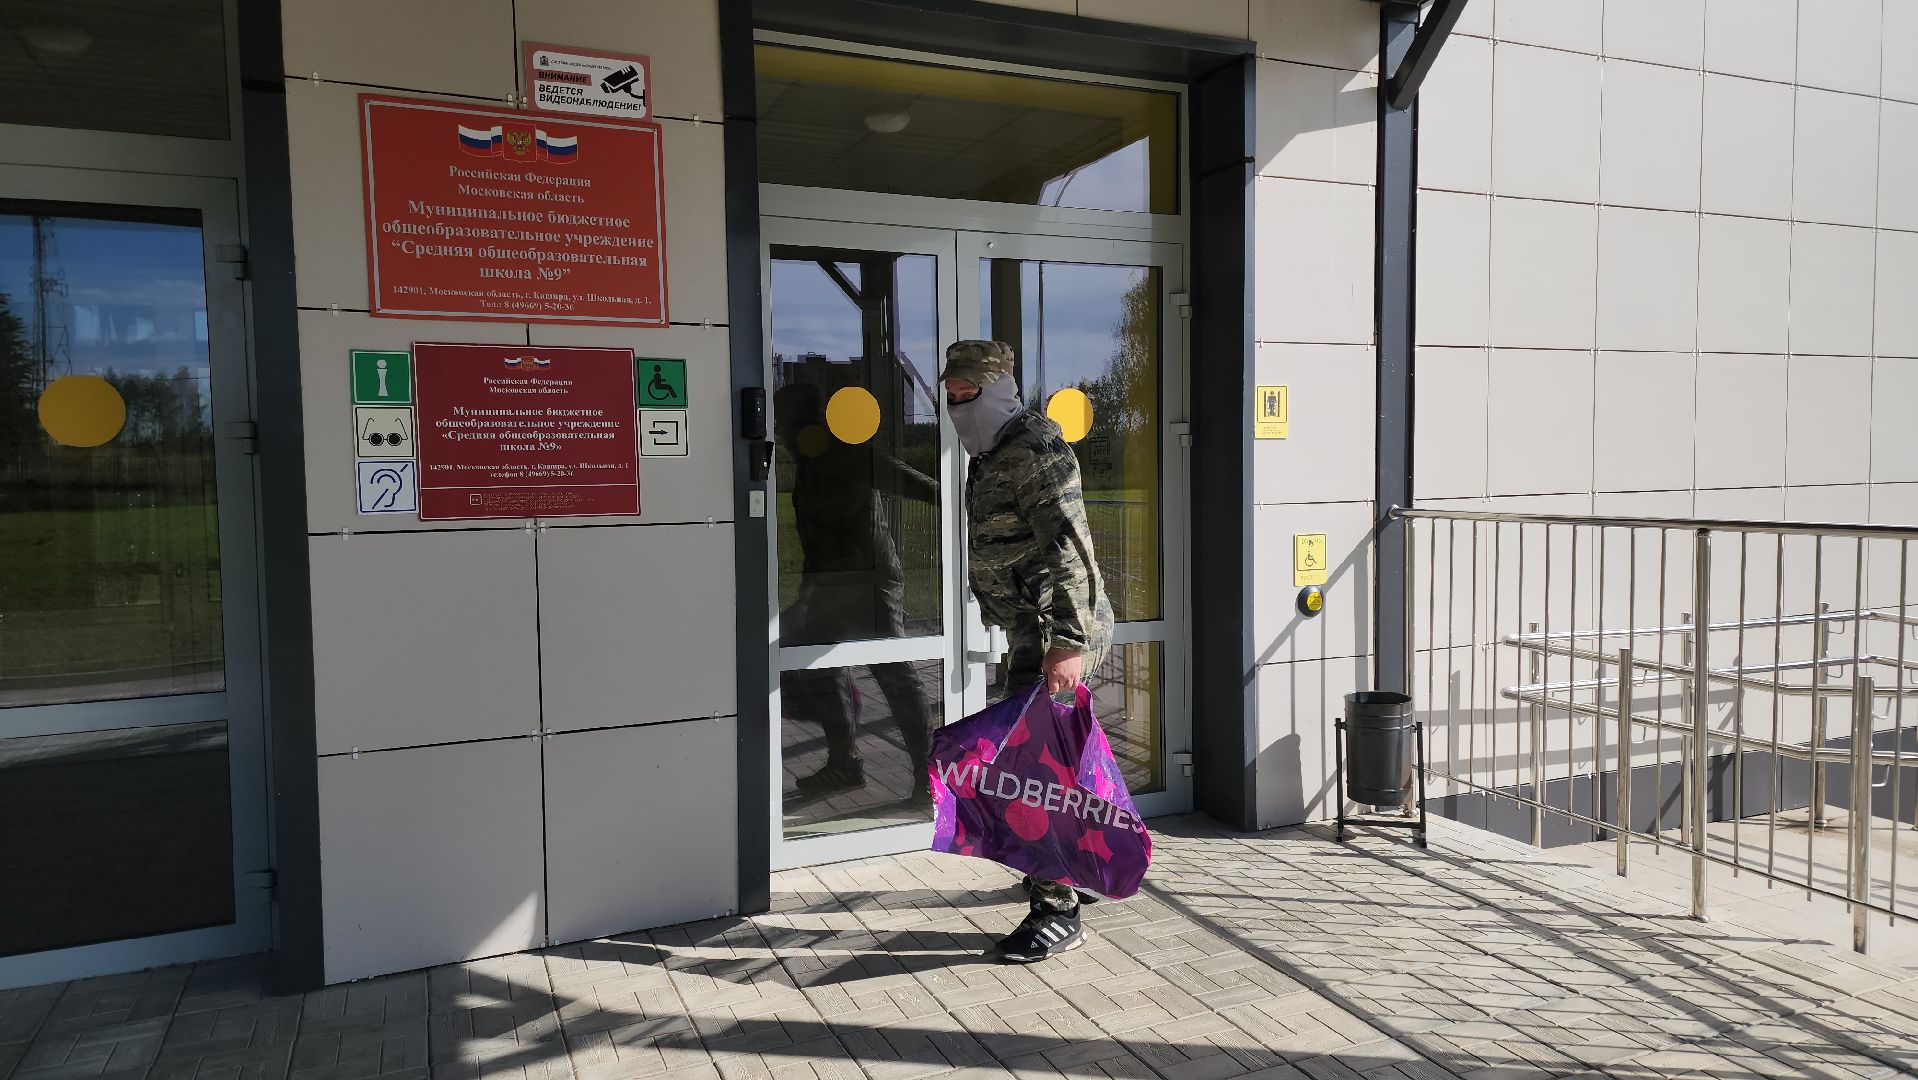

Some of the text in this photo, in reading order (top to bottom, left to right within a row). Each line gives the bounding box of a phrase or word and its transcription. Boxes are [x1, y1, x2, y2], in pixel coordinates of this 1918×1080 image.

[538, 71, 588, 83] ВНИМАНИЕ
[539, 84, 584, 96] ВЕДЕТСЯ
[539, 93, 641, 111] ВИДЕОНАБЛЮДЕНИЕ!
[449, 165, 591, 188] Российская Федерация
[458, 184, 585, 203] Московская область
[408, 200, 631, 228] Муниципальное бюджетное
[382, 219, 654, 248] общеобразовательное учреждение
[478, 245, 647, 267] общеобразовательная
[480, 267, 532, 279] школа
[429, 287, 484, 297] Московская
[486, 290, 524, 299] область,
[572, 294, 585, 303] ул.
[504, 300, 510, 308] 8
[544, 302, 574, 311] 5-20-36
[483, 376, 573, 387] Российская Федерация
[489, 386, 569, 394] Московская область
[453, 406, 604, 418] Муниципальное бюджетное
[435, 419, 620, 430] общеобразовательное учреждение
[442, 430, 615, 441] «Средняя общеобразовательная
[500, 442, 562, 451] школа №9»
[935, 759, 1144, 834] WILDBERRIES
